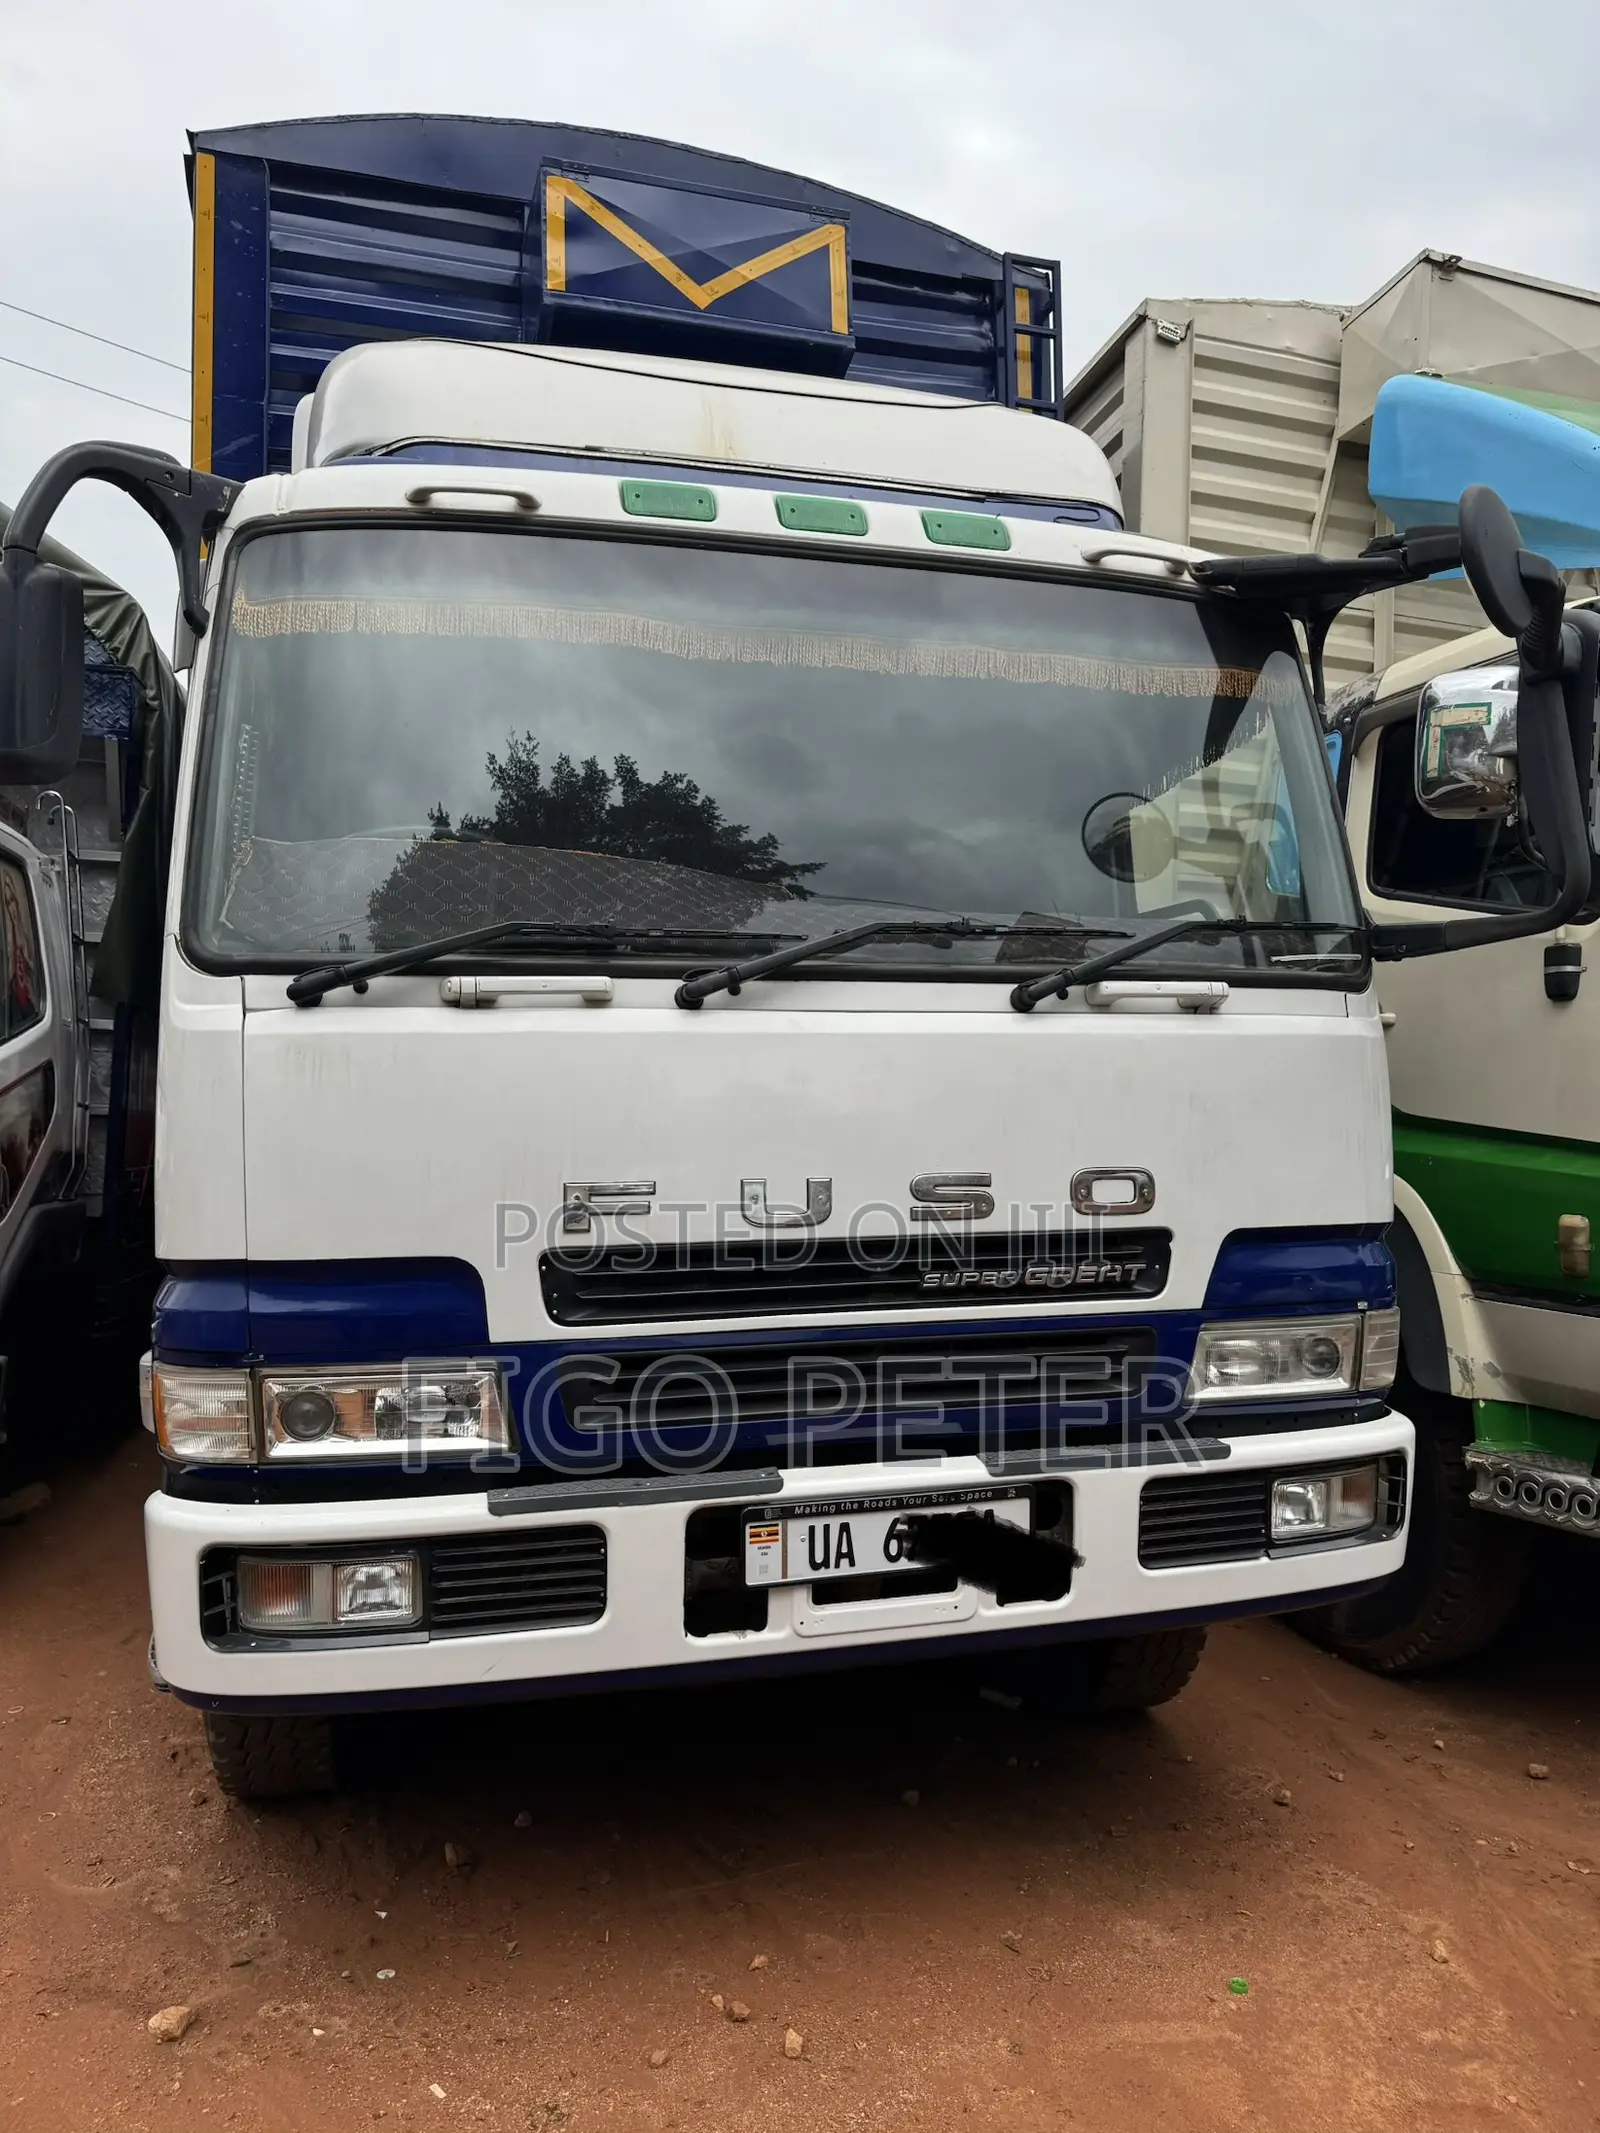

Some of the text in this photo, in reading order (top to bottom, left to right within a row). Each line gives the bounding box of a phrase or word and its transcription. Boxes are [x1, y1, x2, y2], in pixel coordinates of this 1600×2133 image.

[563, 1166, 1156, 1233] FUSO
[921, 1263, 1147, 1289] SUPER GREAT
[794, 1504, 836, 1514] Making
[841, 1501, 859, 1511] the
[863, 1499, 897, 1509] Roads
[902, 1495, 927, 1506] Your
[808, 1522, 856, 1571] UA
